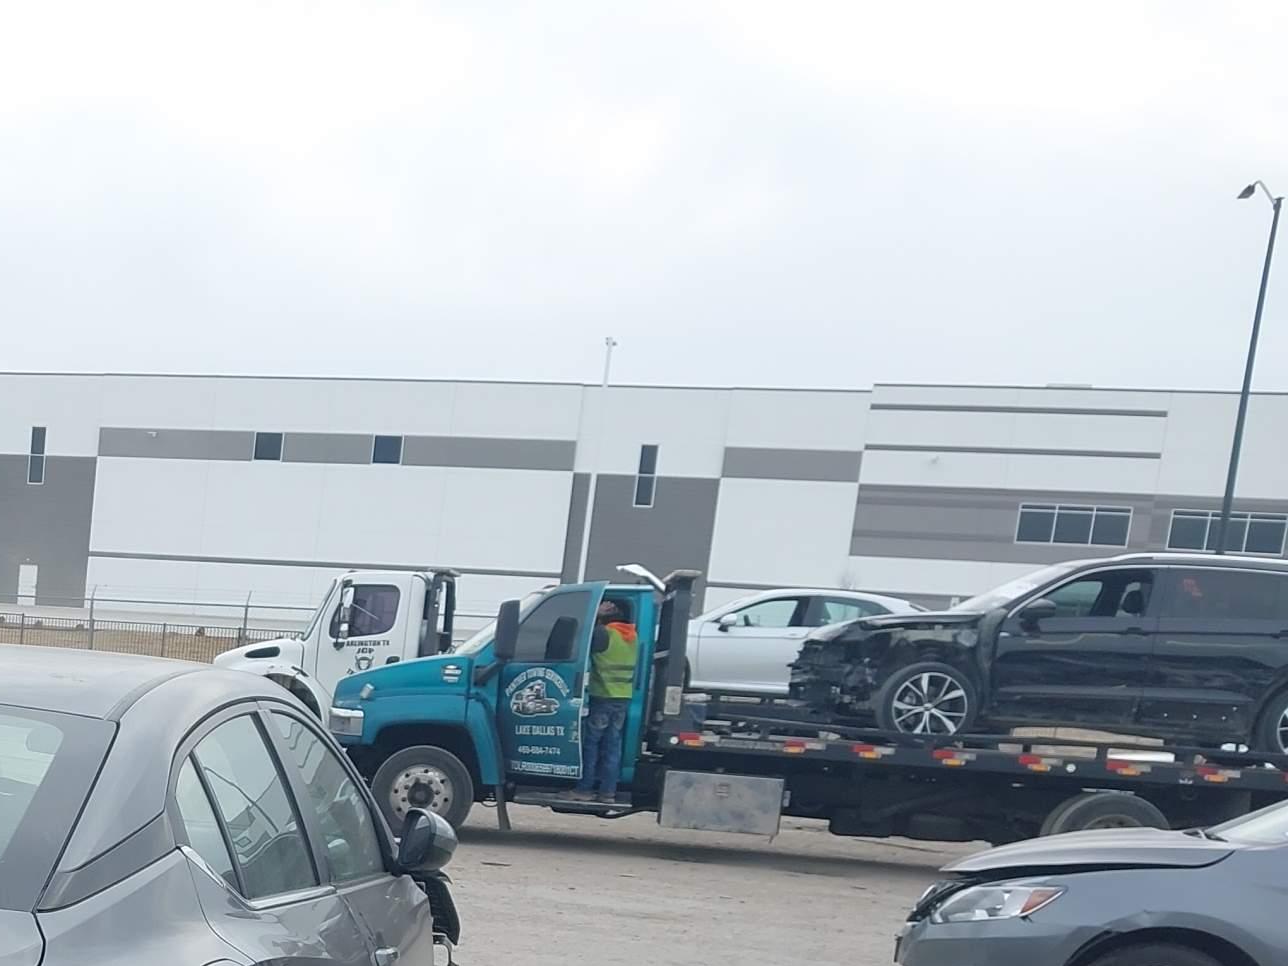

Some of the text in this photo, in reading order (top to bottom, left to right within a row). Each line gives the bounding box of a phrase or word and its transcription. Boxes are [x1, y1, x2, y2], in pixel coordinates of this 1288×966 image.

[515, 725, 565, 737] LAKE DALLAS TX
